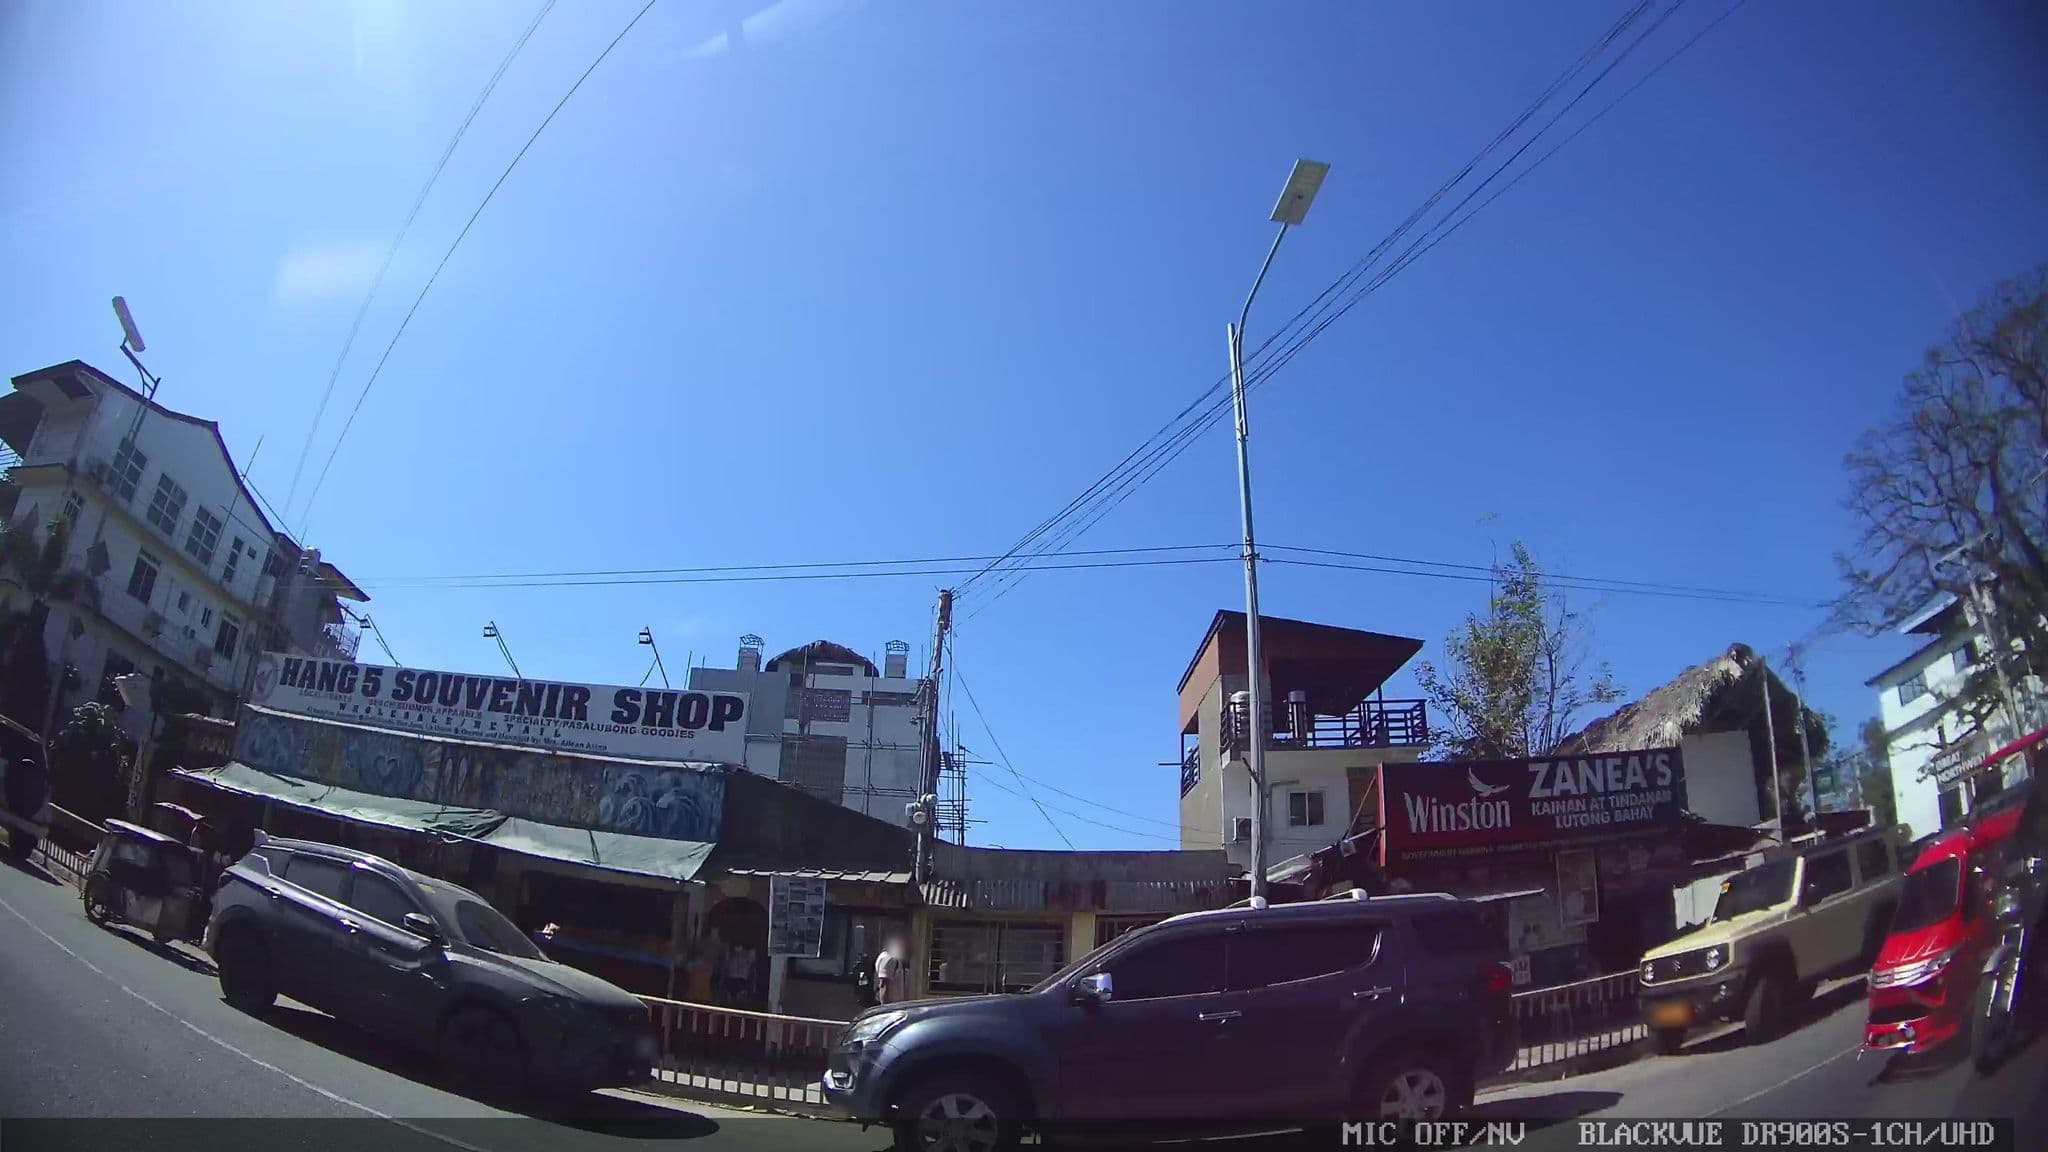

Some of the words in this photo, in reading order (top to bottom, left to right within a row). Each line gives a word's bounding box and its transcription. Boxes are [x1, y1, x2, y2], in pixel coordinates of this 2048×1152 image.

[279, 657, 360, 695] HANG
[361, 667, 385, 698] 5
[391, 670, 591, 721] SOUVENIR
[610, 688, 745, 732] SHOP
[641, 727, 696, 739] GOODIES
[1528, 753, 1673, 799] ZANEA'S
[1403, 791, 1512, 834] Winston
[1532, 798, 1587, 817] KAINAN
[1590, 795, 1606, 812] AT
[1555, 811, 1611, 829] LUTONG
[1614, 805, 1655, 823] BAHAY
